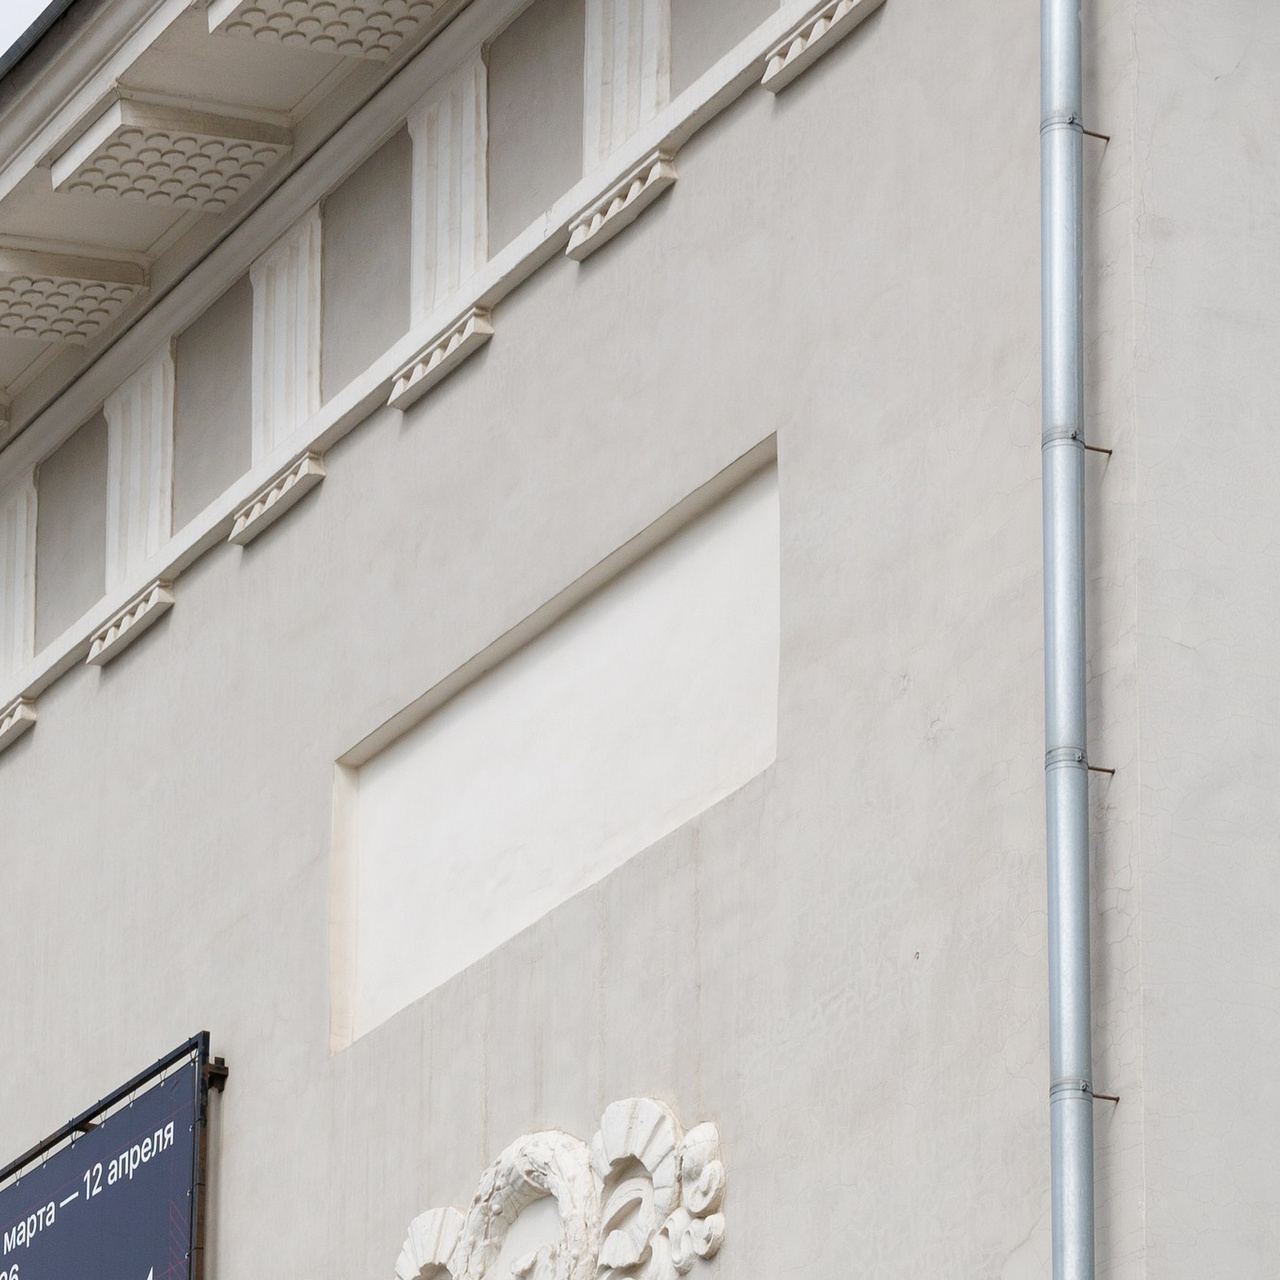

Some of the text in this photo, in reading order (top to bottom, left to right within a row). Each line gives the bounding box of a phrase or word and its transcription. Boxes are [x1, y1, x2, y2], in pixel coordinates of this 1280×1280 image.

[3, 1201, 56, 1255] марта
[83, 1162, 103, 1201] 12
[107, 1121, 175, 1186] апреля
